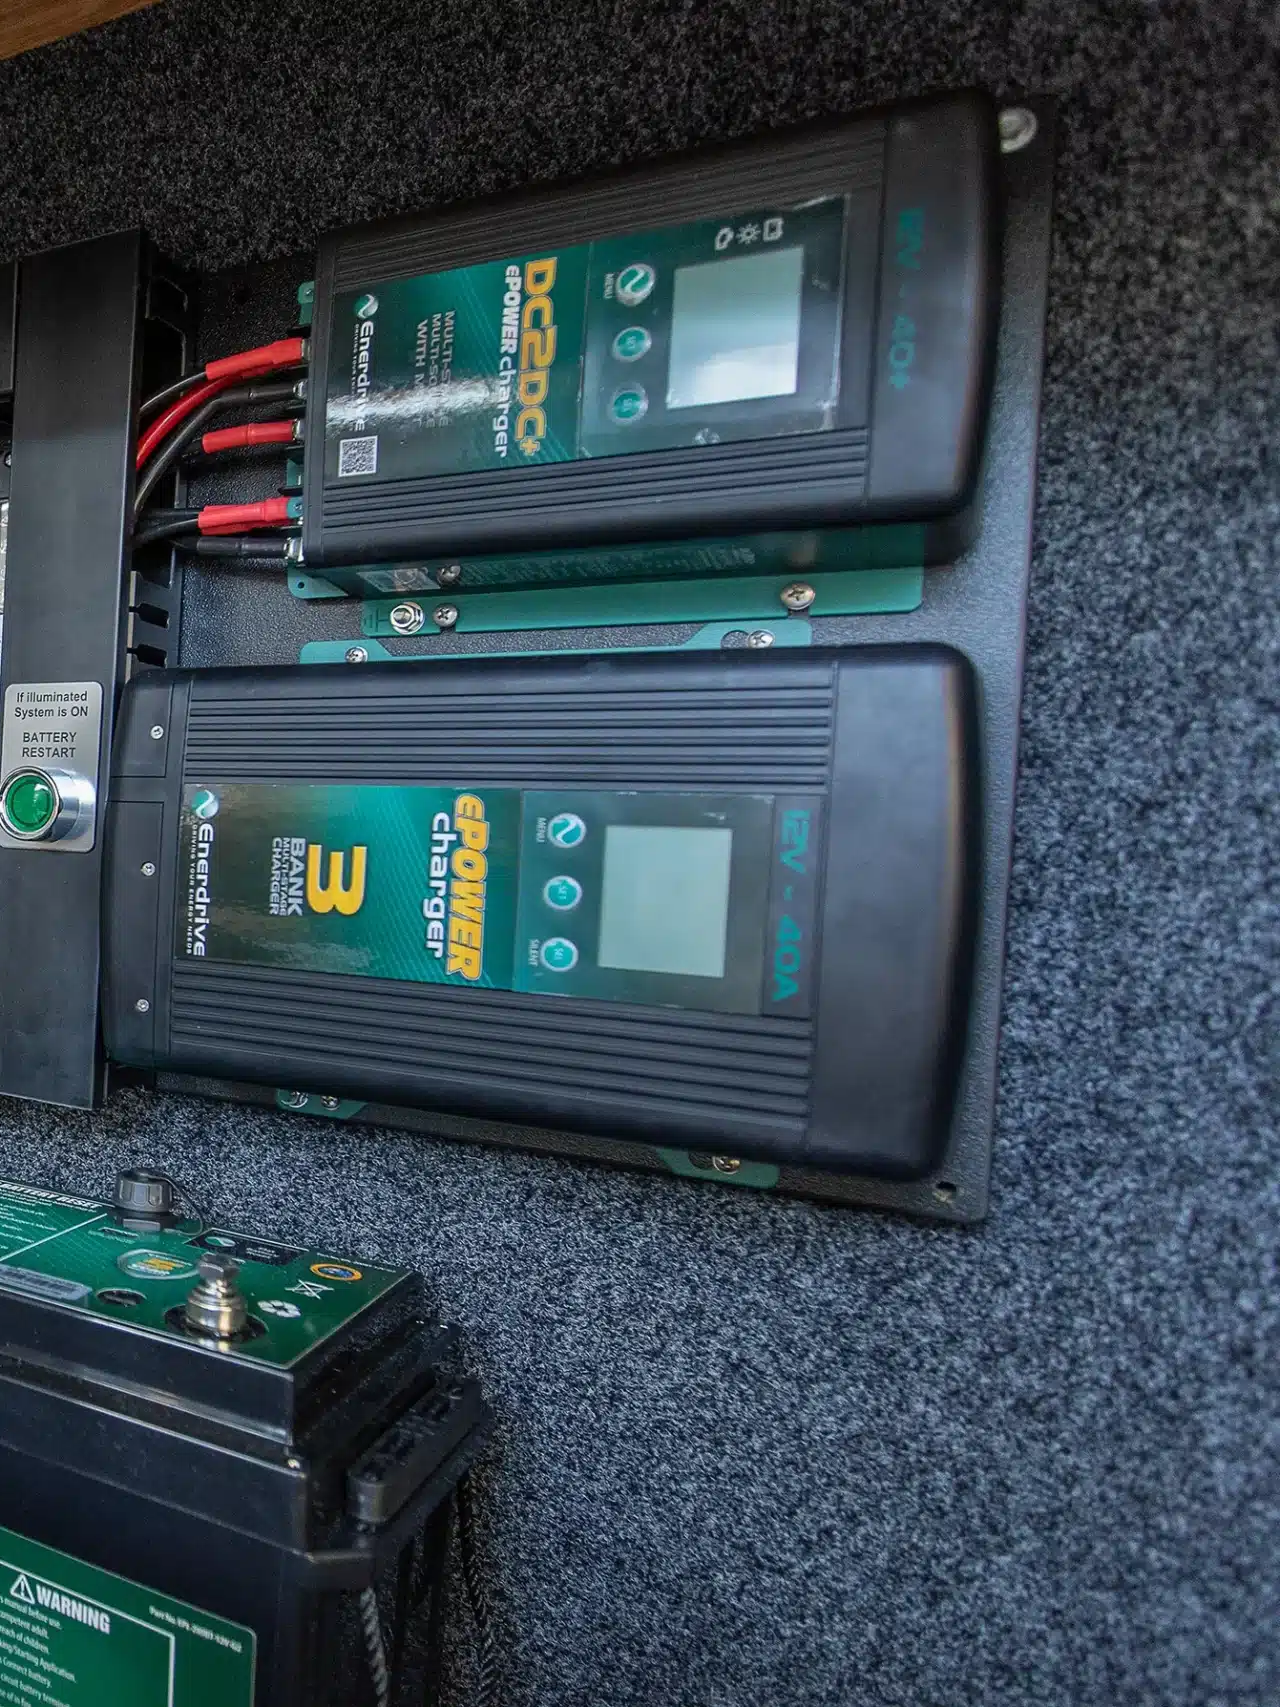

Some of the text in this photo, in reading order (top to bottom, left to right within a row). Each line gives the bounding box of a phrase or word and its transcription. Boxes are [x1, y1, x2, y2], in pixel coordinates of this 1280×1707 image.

[604, 273, 615, 299] MENU
[416, 319, 429, 367] WITH
[515, 256, 558, 456] DC2DC+
[492, 356, 519, 458] charger
[14, 706, 88, 720] System is ON
[17, 690, 88, 702] If illuminated
[22, 747, 76, 758] RESTART
[23, 732, 77, 743] BATTERY
[536, 817, 546, 842] MENU
[781, 808, 811, 874] 12V
[193, 823, 214, 956] Enerdrive
[269, 836, 282, 916] CHARGER
[278, 837, 291, 917] MULTI-STAGE
[287, 837, 307, 917] BANK
[306, 844, 367, 916] 3
[423, 811, 457, 959] charger
[528, 938, 540, 967] SILENT
[773, 914, 803, 1001] 40A
[0, 1182, 58, 1202] BATTERY
[60, 1194, 104, 1210] RESET
[0, 1624, 15, 1637] reach
[16, 1631, 23, 1641] of
[4, 1598, 28, 1614] manual
[28, 1607, 49, 1623] before
[36, 1584, 111, 1635] WARNING
